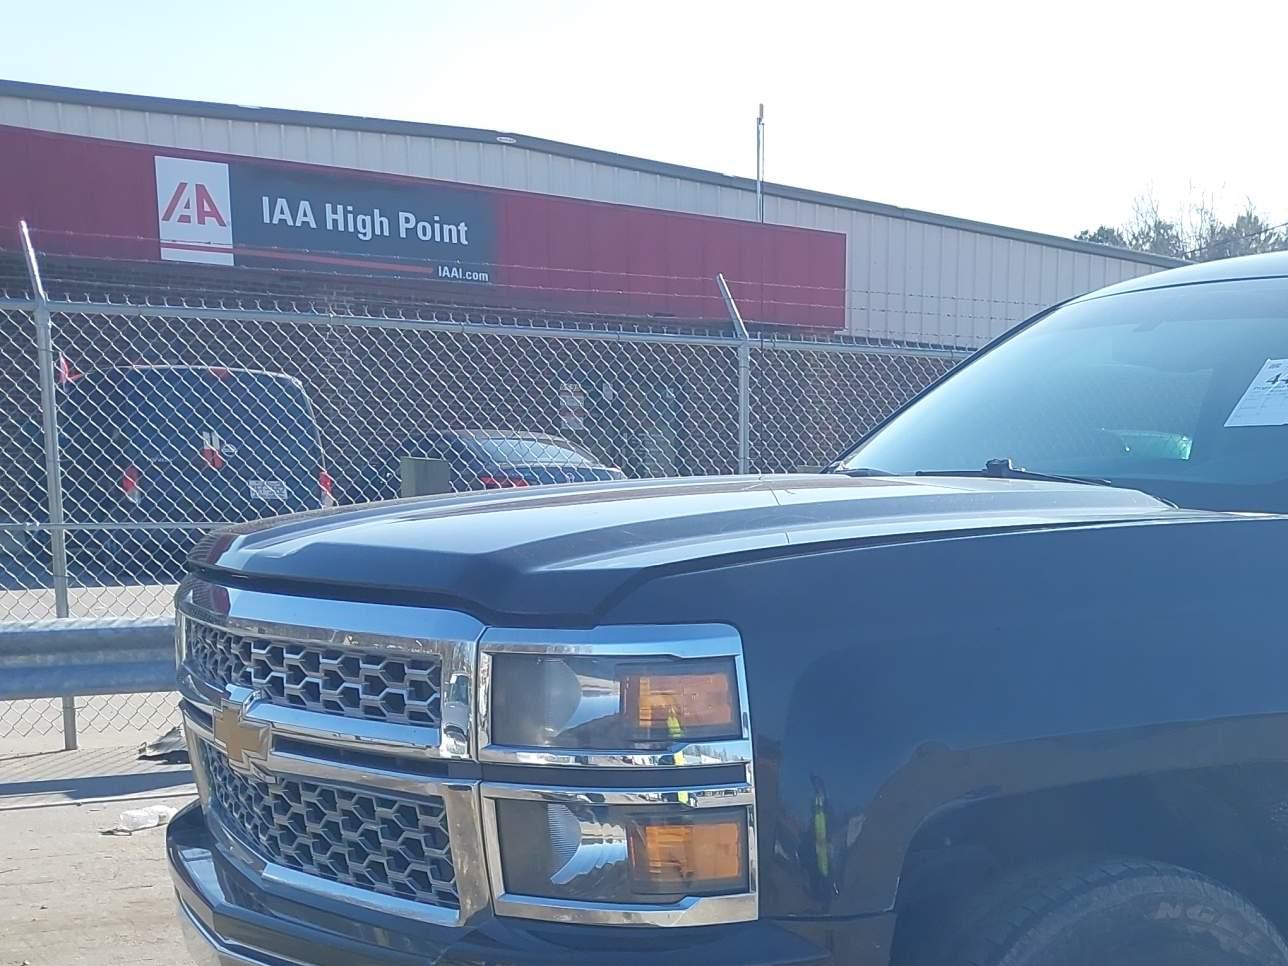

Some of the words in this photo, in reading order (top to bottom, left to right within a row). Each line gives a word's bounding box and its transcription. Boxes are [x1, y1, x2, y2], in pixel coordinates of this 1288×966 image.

[262, 196, 317, 229] IAA
[325, 203, 390, 240] High
[399, 211, 468, 245] Point
